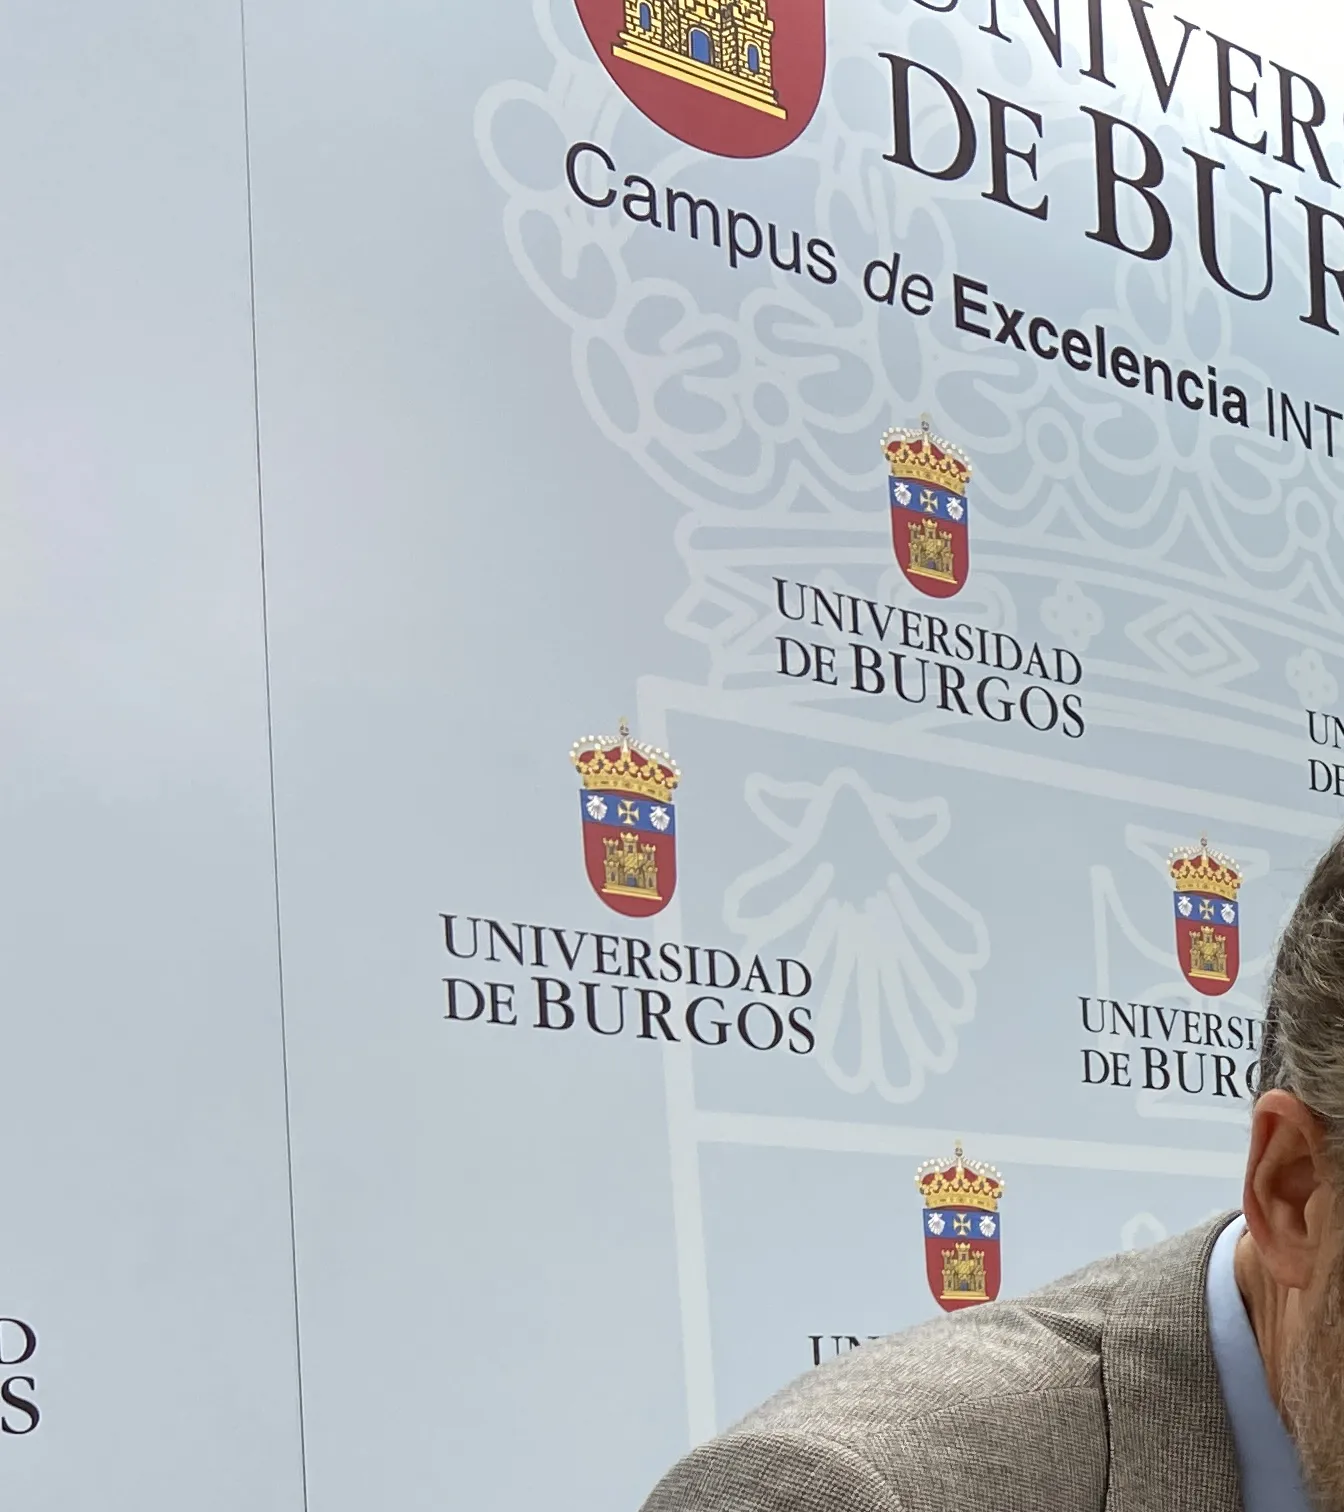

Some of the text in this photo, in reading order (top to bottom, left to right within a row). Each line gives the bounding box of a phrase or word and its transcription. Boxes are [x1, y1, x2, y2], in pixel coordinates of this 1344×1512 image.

[878, 51, 1050, 221] DE
[566, 141, 838, 285] Campus
[863, 251, 934, 316] de
[953, 273, 1250, 428] Excelencia
[772, 577, 1084, 686] UNIVERSIDAD
[776, 636, 1086, 739] DE BURGOS
[438, 913, 813, 998] UNIVERSIDAD
[443, 976, 816, 1055] DE BURGOS
[1078, 996, 1262, 1051] UNIVERSI
[1081, 1046, 1262, 1099] DE BUR
